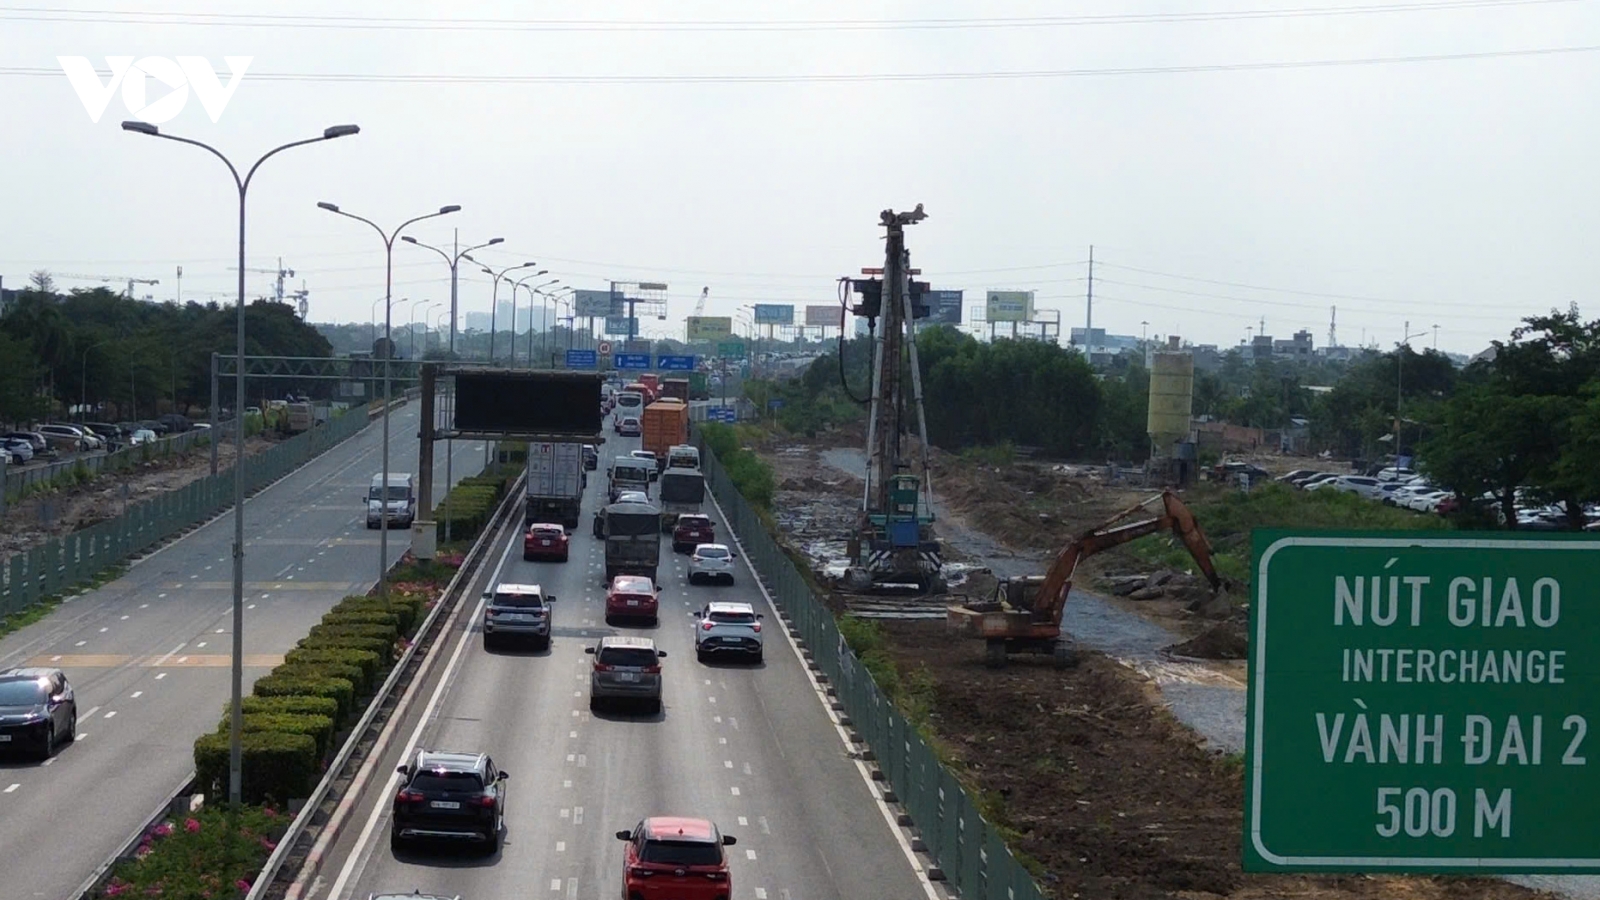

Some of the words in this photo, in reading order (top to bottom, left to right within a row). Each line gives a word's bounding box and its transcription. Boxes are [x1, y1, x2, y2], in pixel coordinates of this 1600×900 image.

[1334, 558, 1430, 626] NÚT
[1448, 576, 1560, 628] GIAO
[1343, 648, 1566, 683] INTERCHANGE
[1316, 698, 1443, 764] VÀNH
[1461, 715, 1542, 765] ĐAI
[1562, 714, 1587, 765] 2
[1376, 787, 1456, 837] 500
[1474, 788, 1511, 838] M
